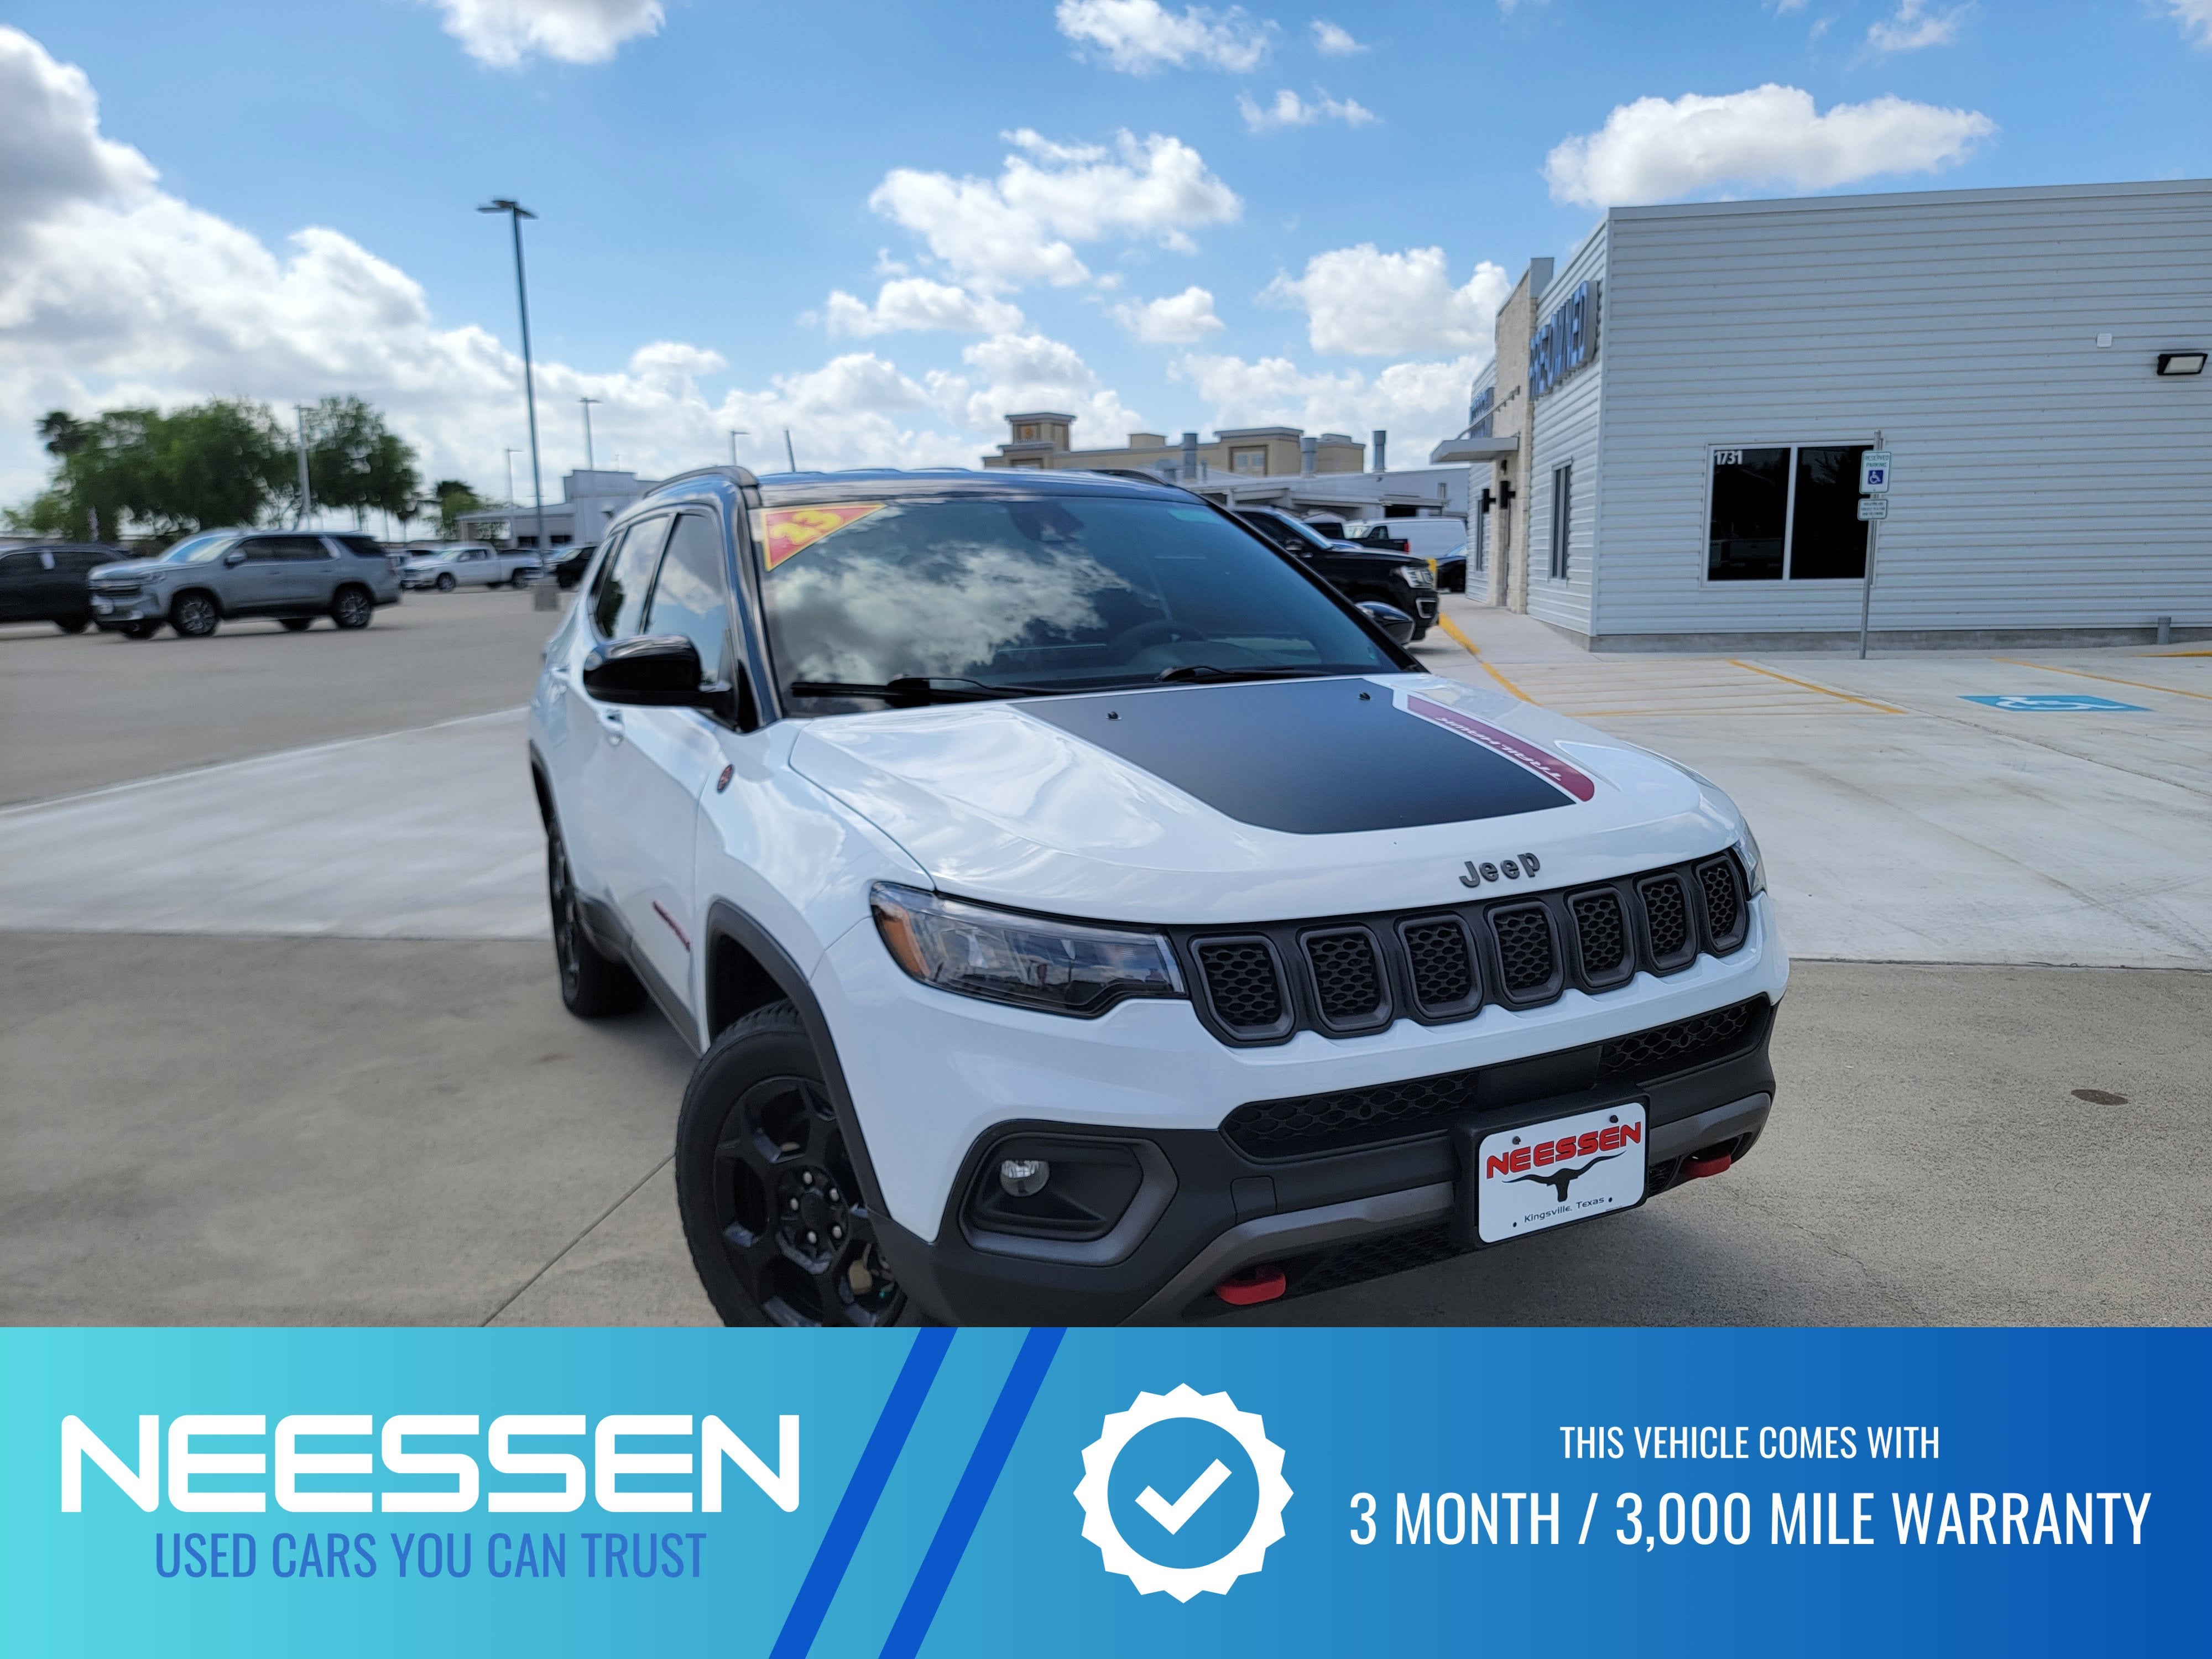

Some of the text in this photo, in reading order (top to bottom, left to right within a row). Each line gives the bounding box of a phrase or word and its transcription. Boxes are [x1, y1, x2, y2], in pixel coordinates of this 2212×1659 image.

[1714, 451, 1743, 465] 1731
[1459, 853, 1540, 888] Jeep
[1486, 1121, 1641, 1179] NEESSEN
[1576, 1197, 1604, 1209] Texas
